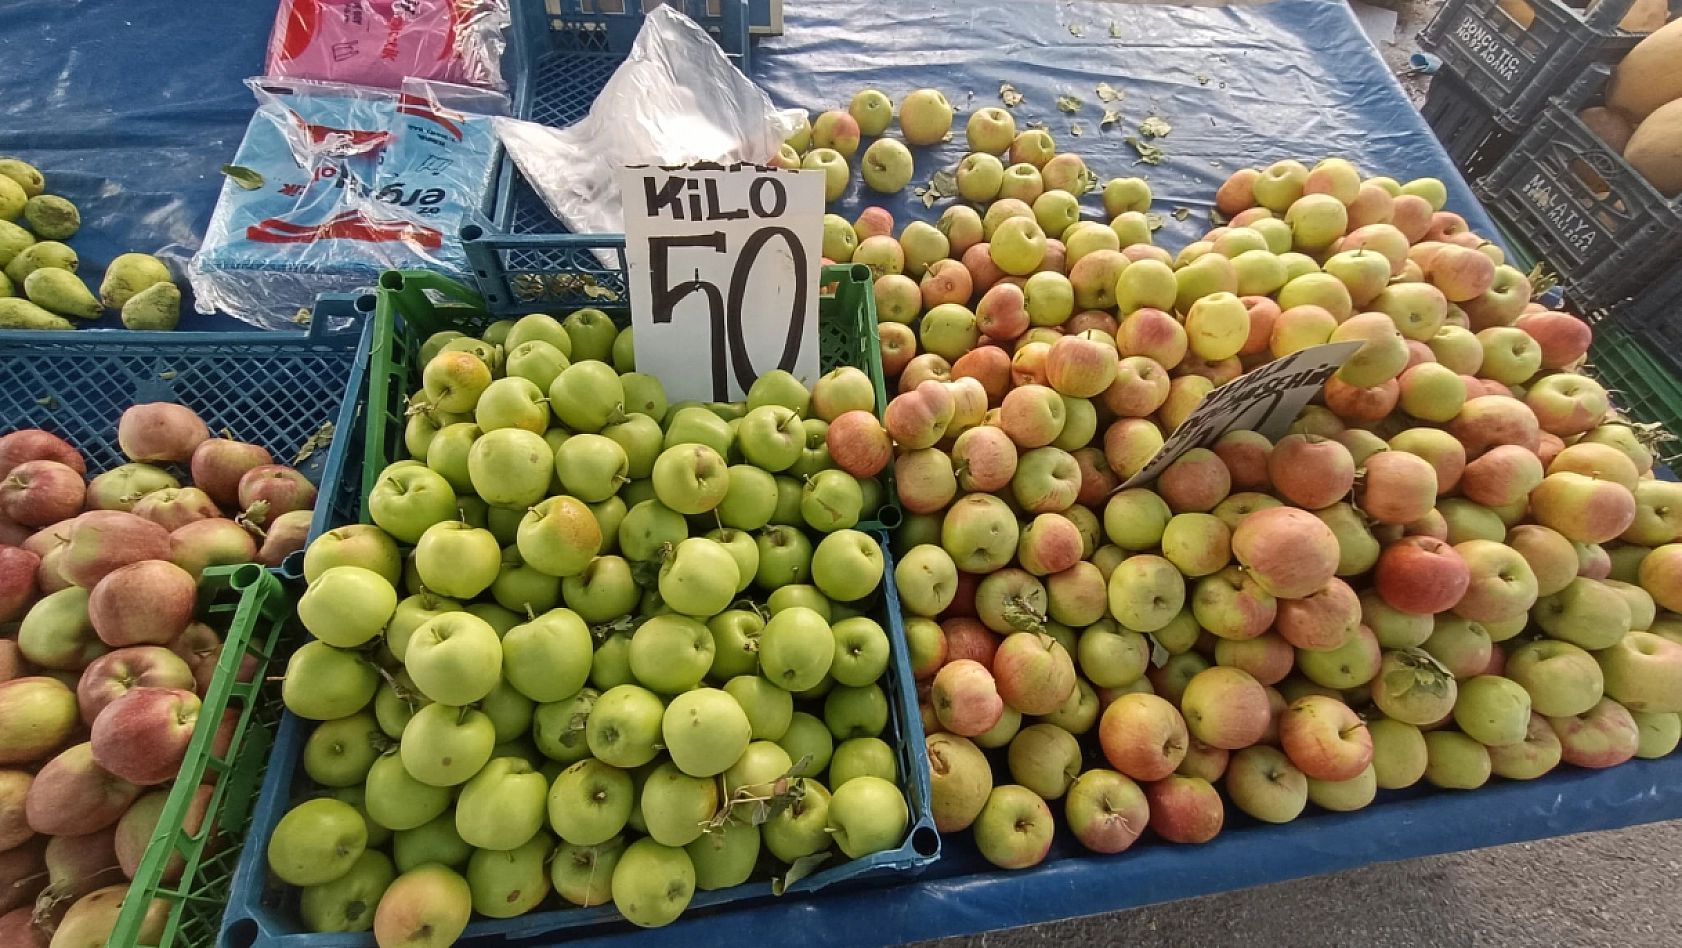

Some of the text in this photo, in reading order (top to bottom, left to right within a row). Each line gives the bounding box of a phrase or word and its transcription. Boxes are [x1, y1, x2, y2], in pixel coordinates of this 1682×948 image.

[1480, 50, 1513, 81] ADANA
[1529, 173, 1596, 246] MALATYA
[648, 226, 807, 403] 50
